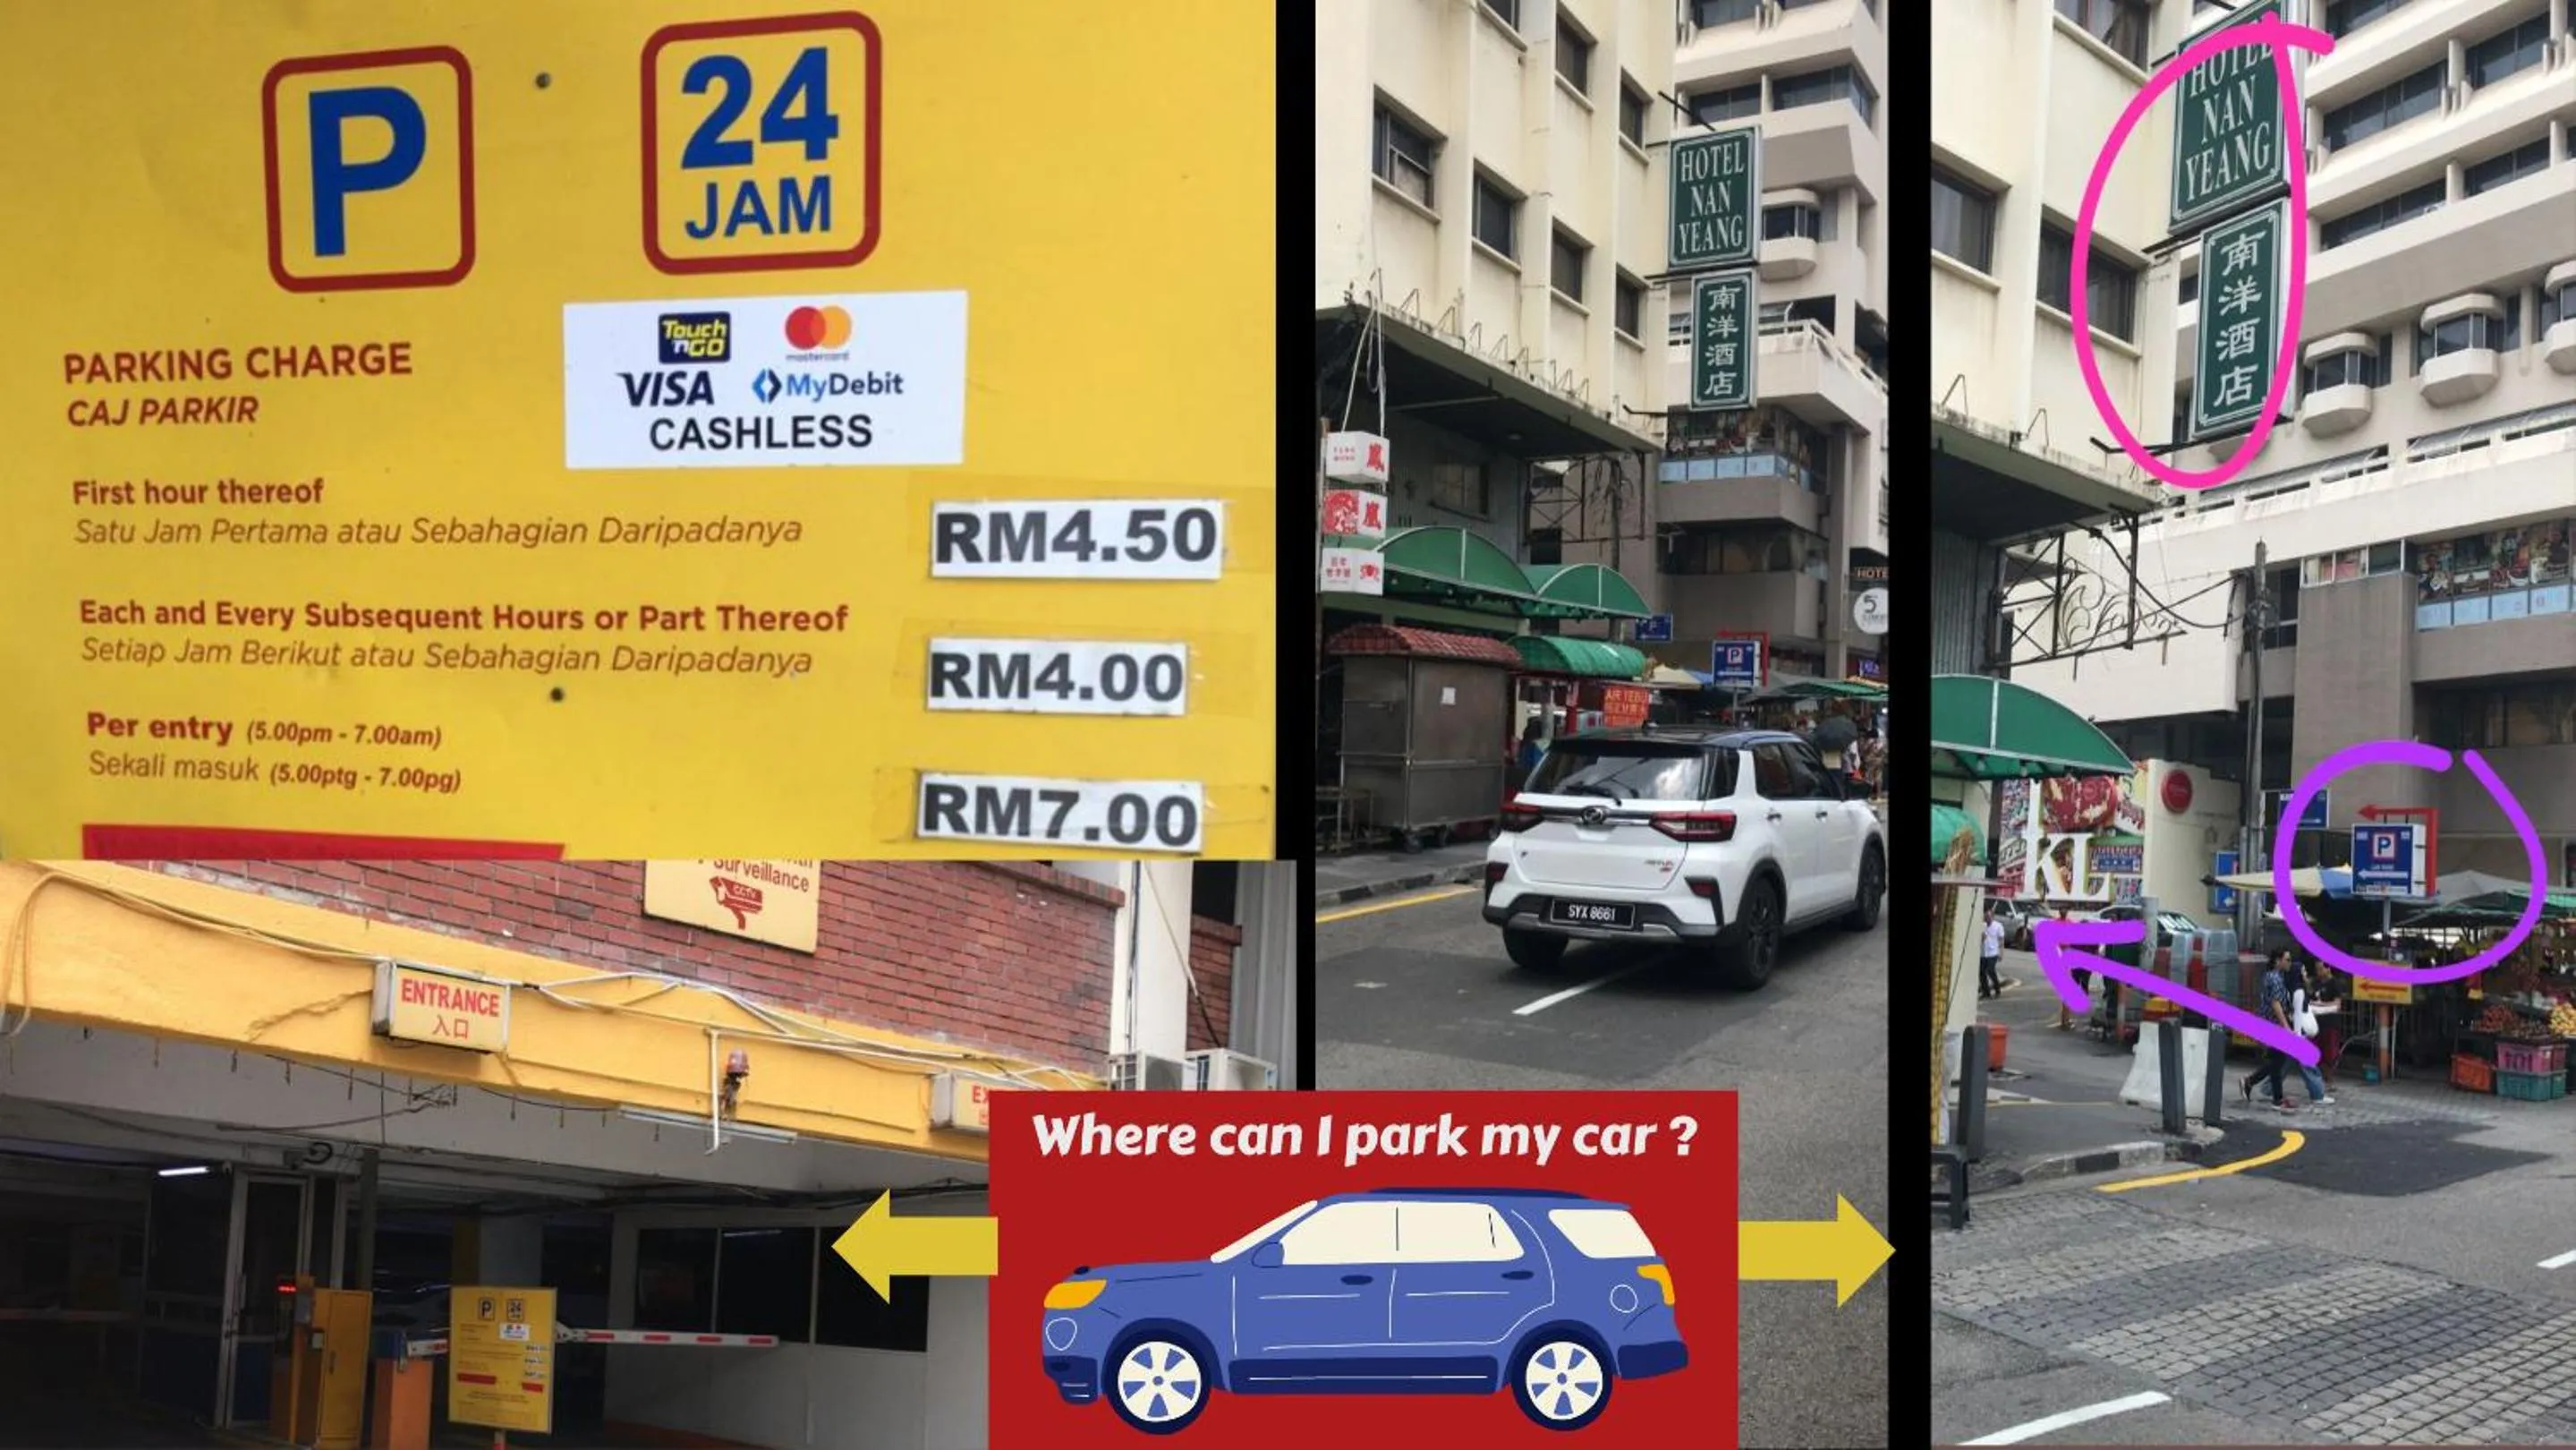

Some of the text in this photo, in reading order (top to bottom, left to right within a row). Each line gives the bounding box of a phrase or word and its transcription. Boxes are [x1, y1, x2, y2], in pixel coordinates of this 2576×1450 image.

[680, 47, 839, 170] 24
[2201, 75, 2256, 144] NAN
[309, 86, 427, 257] P
[1680, 141, 1745, 183] HOTEL
[2185, 122, 2270, 202] YEANG
[684, 175, 831, 240] JAM
[1690, 180, 1731, 218] NAN
[1679, 215, 1743, 254] YEANG
[662, 318, 727, 340] Touch
[2213, 229, 2266, 407] 南洋酒店
[1704, 286, 1743, 397] 南洋酒店
[64, 342, 412, 384] PARKING CHARGE
[616, 371, 715, 407] VISA
[786, 371, 904, 403] MyDebit
[67, 396, 259, 427] CAJ PARKIR
[650, 414, 872, 450] CASHLESS
[73, 478, 324, 505] First hour thereof
[74, 515, 803, 549] Satu Jam Pertama atau Sebahagian Daripadanya
[935, 508, 1217, 565] RM4.50
[81, 601, 848, 632] Each and Every Subsequent Hours or Part Thereof
[81, 637, 812, 677] Setiap Jam Berikut atau Sebahagian Daripadanya
[930, 652, 1183, 702] RM4.00
[88, 712, 139, 738] Per
[149, 715, 234, 745] entry
[246, 721, 333, 746] (5.00pm
[354, 726, 442, 750] 7.00am)
[89, 751, 166, 779] Sekali
[174, 756, 259, 781] masuk
[269, 763, 357, 790] (5.00ptg
[378, 767, 461, 794] 7.00pg)
[922, 782, 1197, 847] RM7.00
[2377, 836, 2391, 855] P
[1569, 905, 1588, 919] SYX
[402, 978, 500, 1018] ENTRANCE
[432, 1014, 469, 1039] 入口
